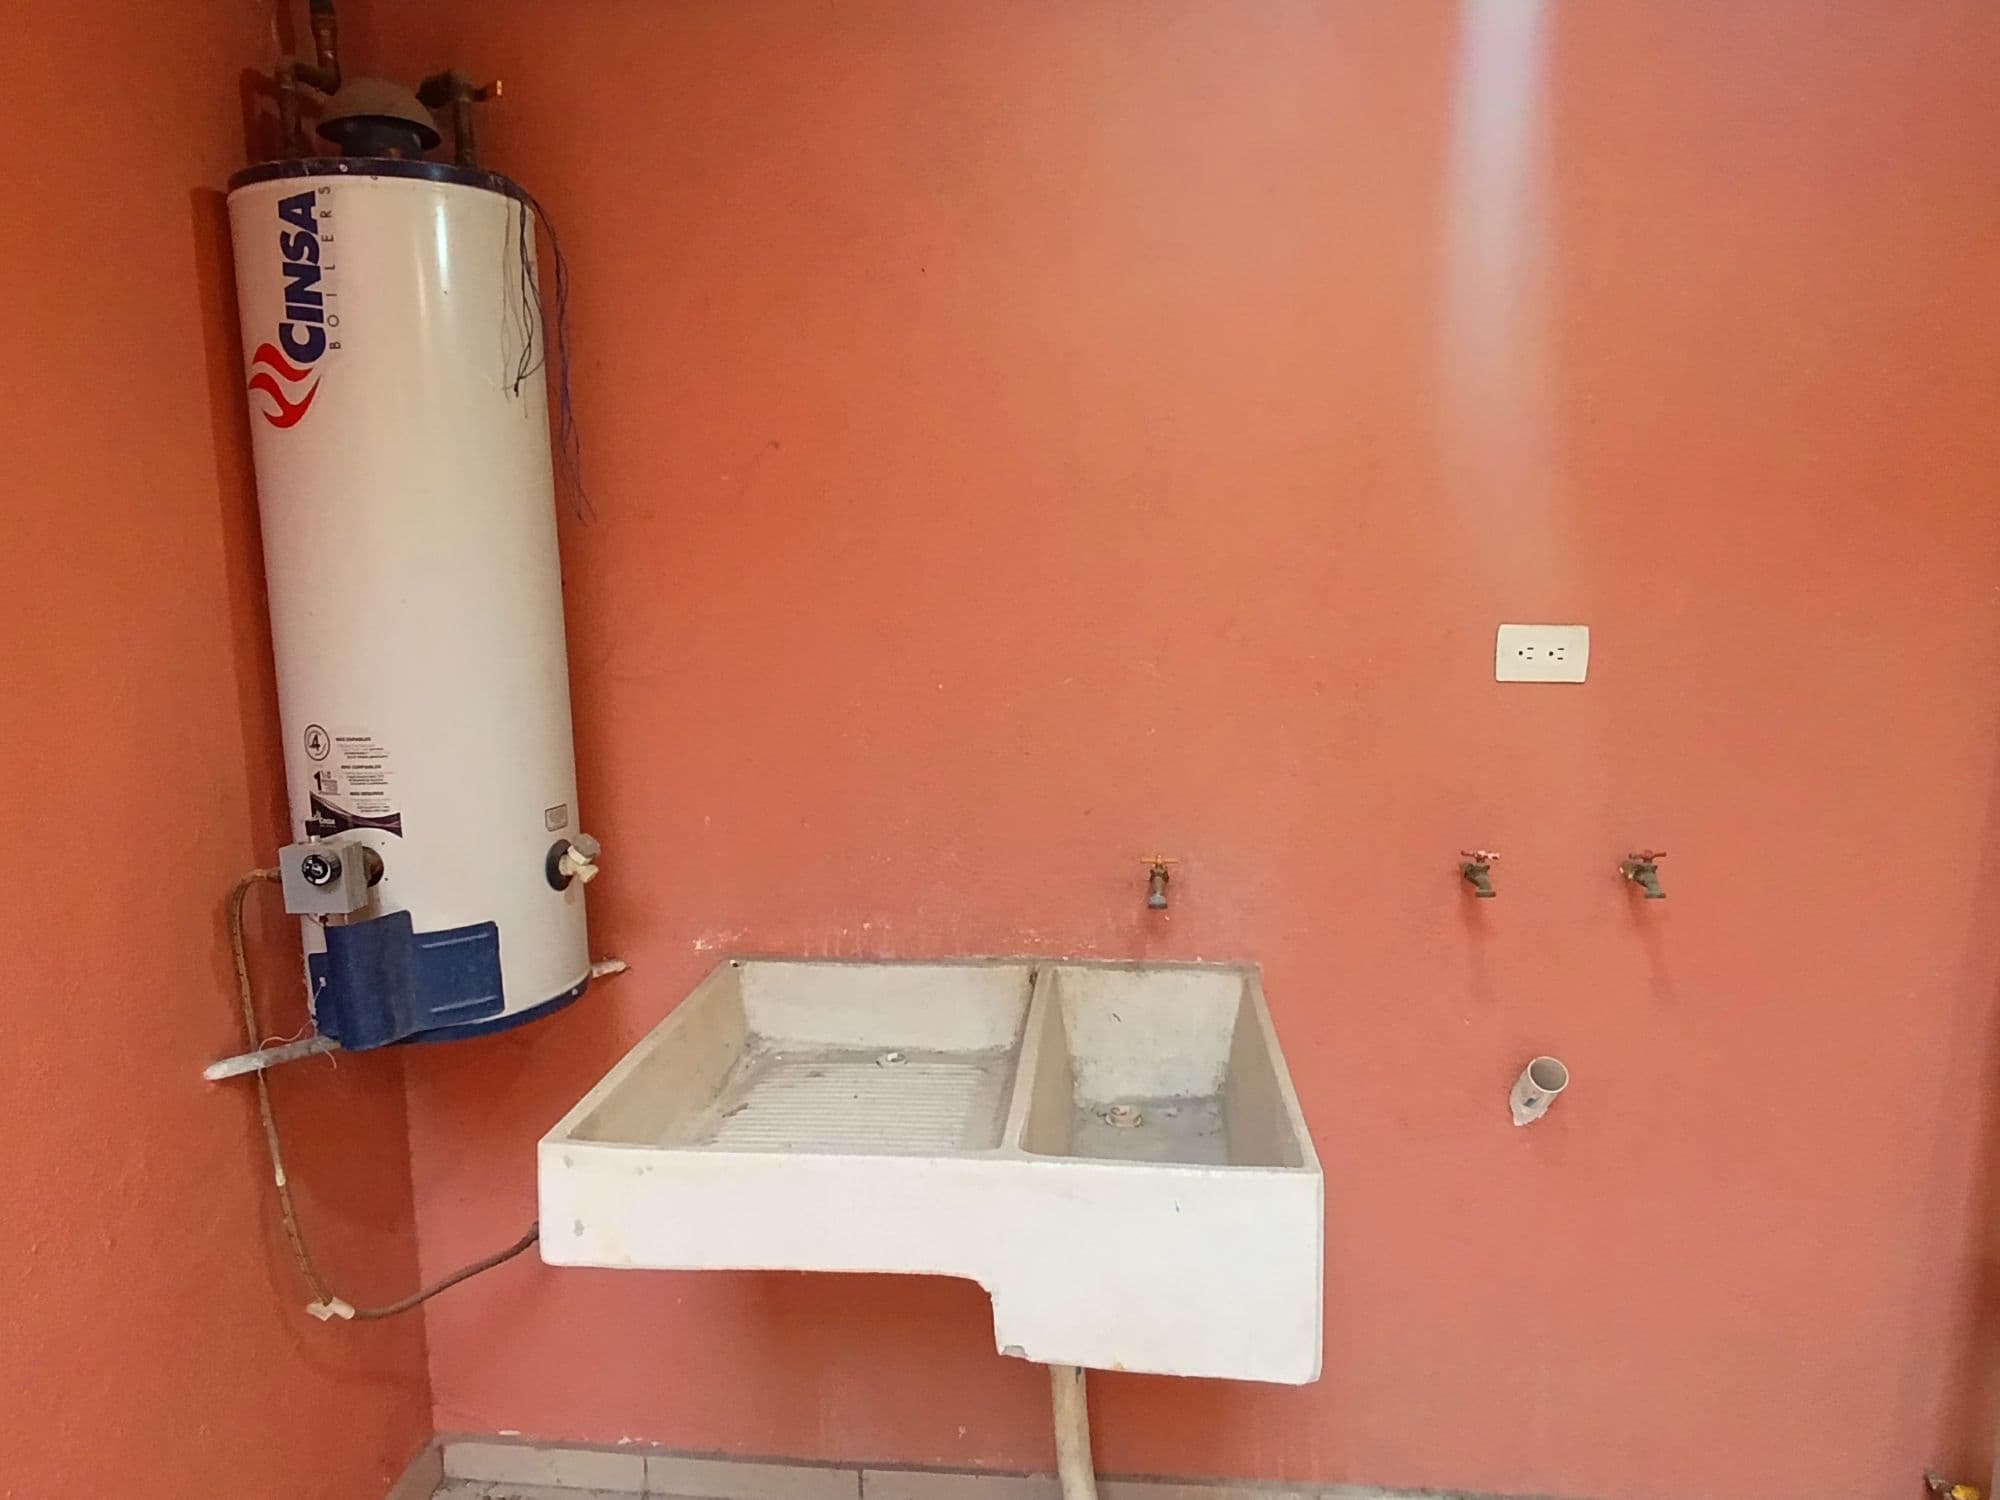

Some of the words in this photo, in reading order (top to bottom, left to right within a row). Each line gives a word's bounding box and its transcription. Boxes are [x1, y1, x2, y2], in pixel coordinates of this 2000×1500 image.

[278, 190, 327, 364] CINSA
[318, 186, 341, 350] BOILERS
[309, 735, 321, 751] 4
